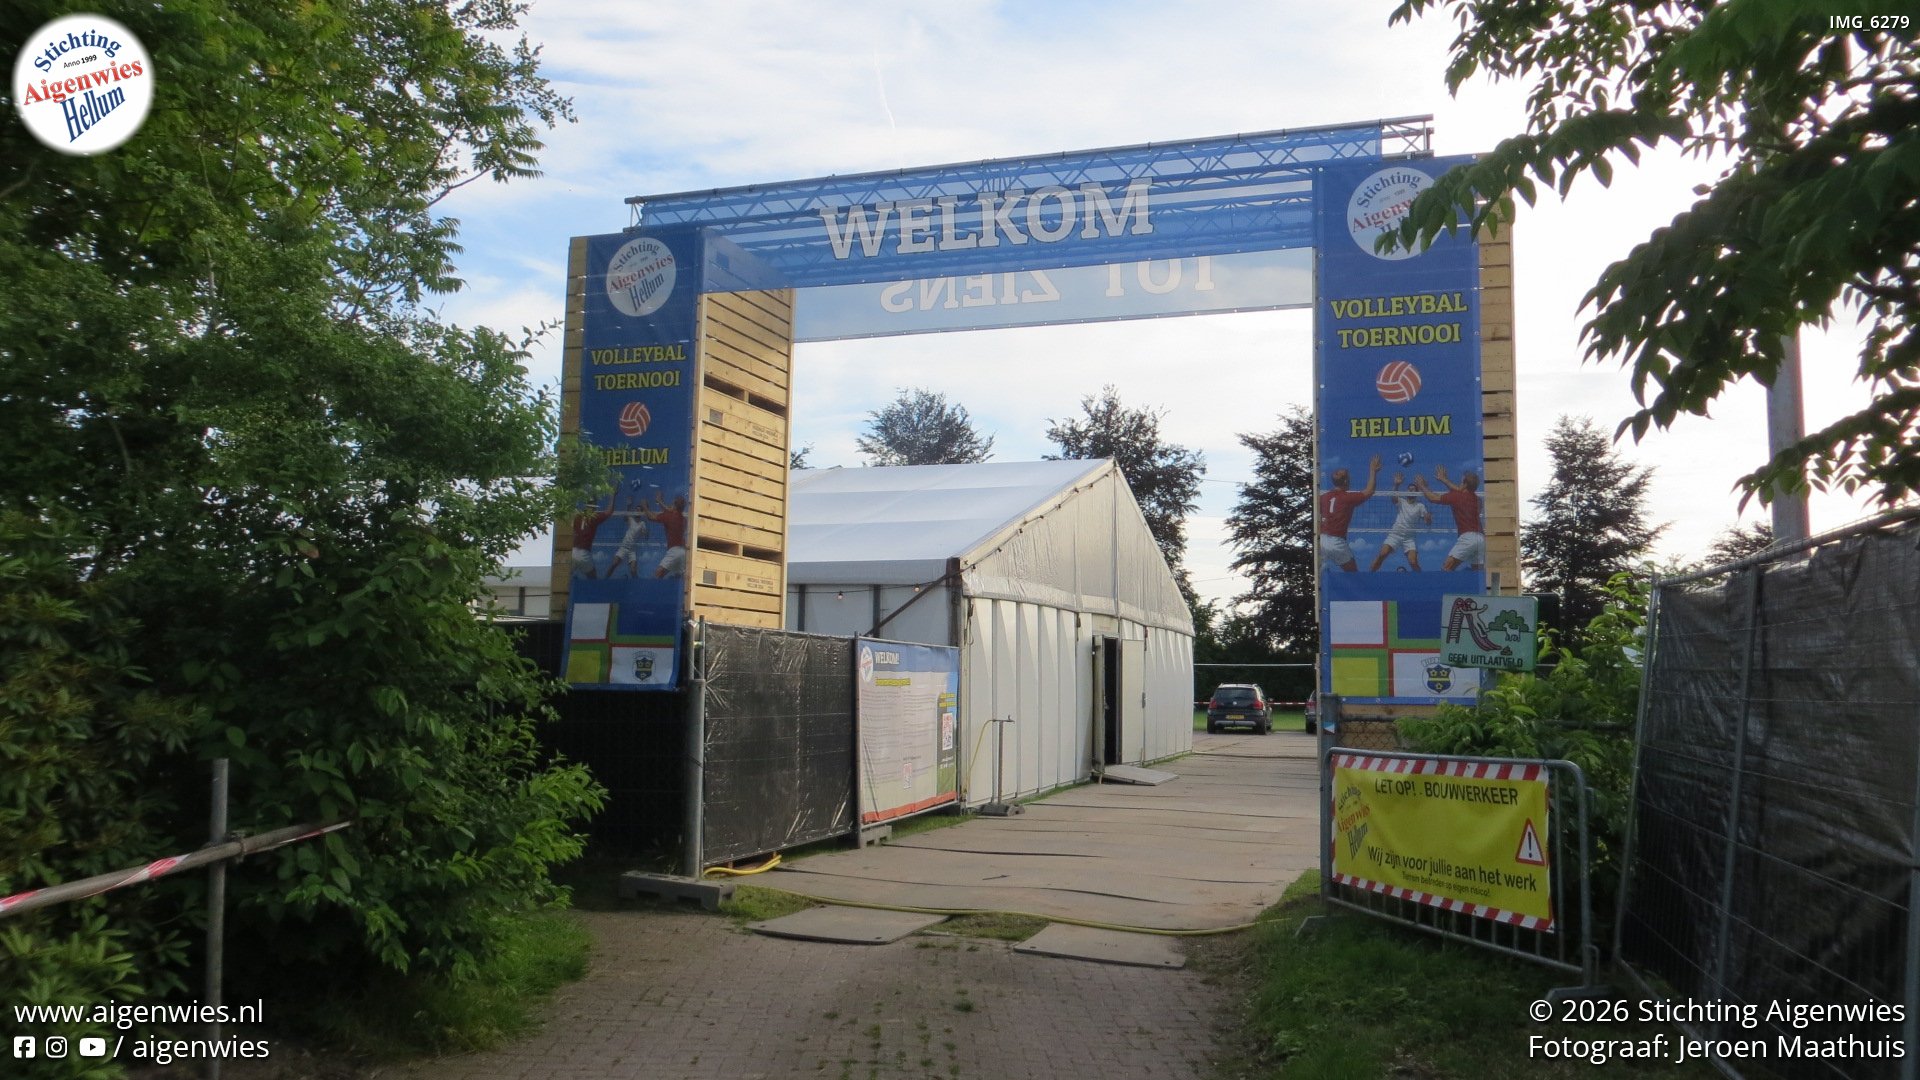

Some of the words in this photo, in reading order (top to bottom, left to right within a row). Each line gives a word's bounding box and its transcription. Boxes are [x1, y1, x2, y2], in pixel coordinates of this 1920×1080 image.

[1356, 172, 1421, 208] Stichting
[817, 176, 1155, 260] WELKOM
[613, 241, 661, 272] Stichting
[609, 254, 674, 293] Aigenwies
[628, 273, 665, 313] Hellum
[1330, 292, 1468, 320] VOLLEYBAL
[1336, 322, 1461, 349] TOERNOOI
[591, 344, 687, 366] VOLLEYBAL
[594, 370, 681, 391] TOERNOOI
[1350, 414, 1452, 438] HELLUM
[1328, 496, 1337, 514] 1
[1448, 652, 1468, 664] GEEN
[1470, 655, 1524, 668] UITLAATVELD
[1374, 778, 1393, 794] LET
[1396, 780, 1417, 797] OP!
[1424, 781, 1519, 806] BOUWVERKEER
[1368, 845, 1382, 866] Wij
[1384, 851, 1401, 869] zijn
[1403, 855, 1428, 871] voor
[1429, 857, 1452, 876] jullie
[1455, 866, 1476, 881] aan
[1479, 865, 1502, 886] het
[1504, 873, 1537, 892] werk
